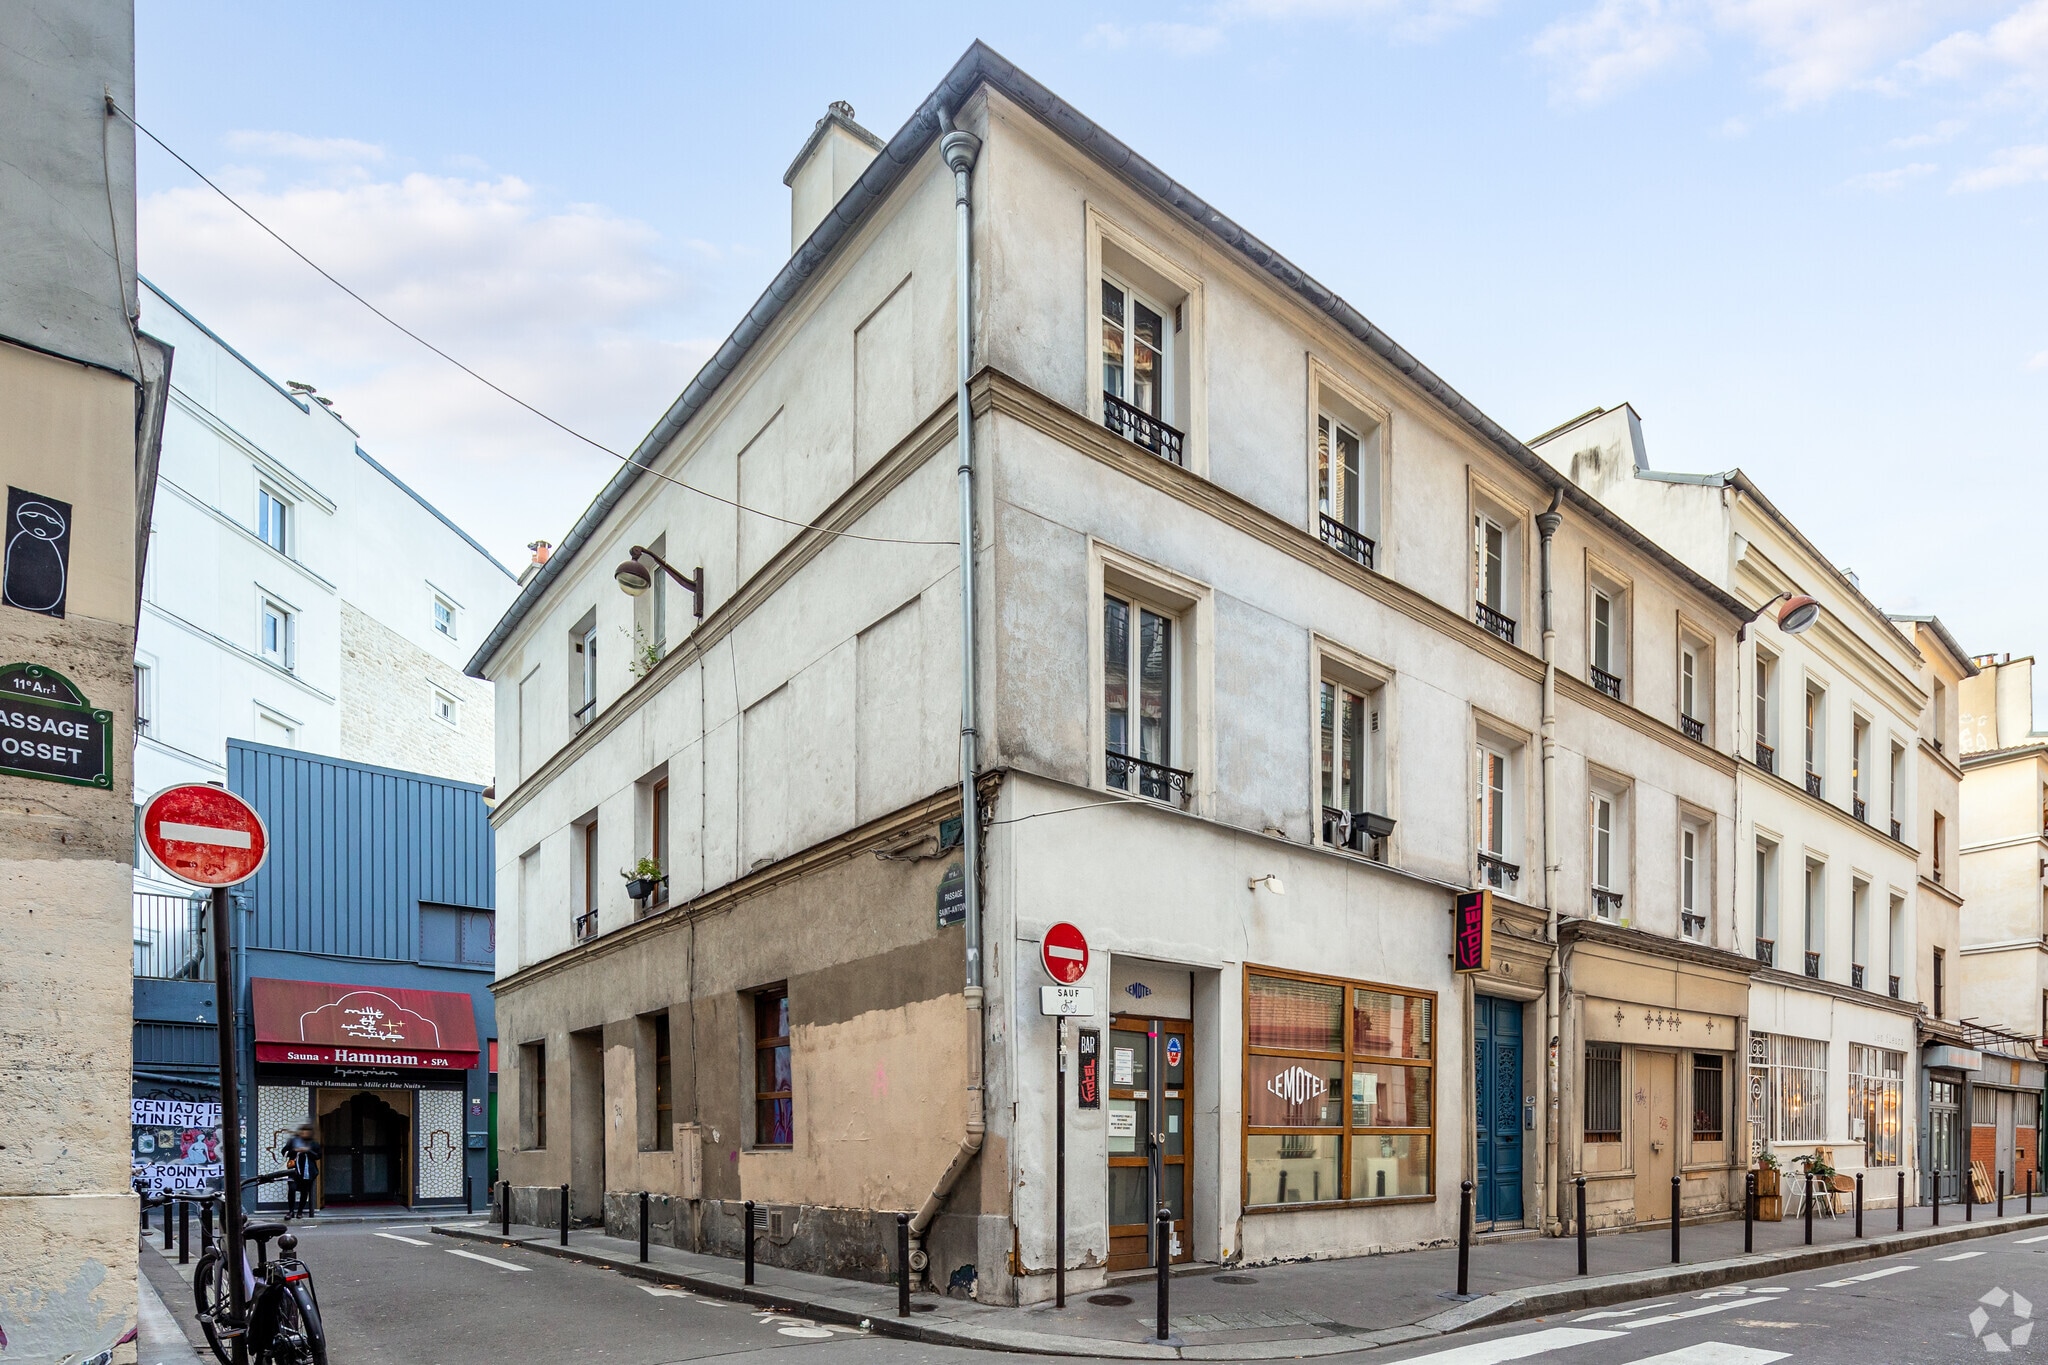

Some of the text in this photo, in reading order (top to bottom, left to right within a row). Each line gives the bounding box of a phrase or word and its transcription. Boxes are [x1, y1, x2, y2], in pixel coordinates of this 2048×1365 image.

[0, 709, 89, 740] ASSAGE
[1, 738, 83, 764] OSSET
[944, 889, 963, 902] PASSAGE
[939, 902, 966, 917] SAINT-ANTOIN
[1057, 989, 1080, 998] SAUF
[1081, 1036, 1095, 1054] BAR
[287, 1049, 449, 1066] Sauna Hammam SPA
[133, 1100, 222, 1114] CENIAJCIE
[132, 1112, 211, 1126] MINISTKI
[175, 1178, 206, 1189] DLA
